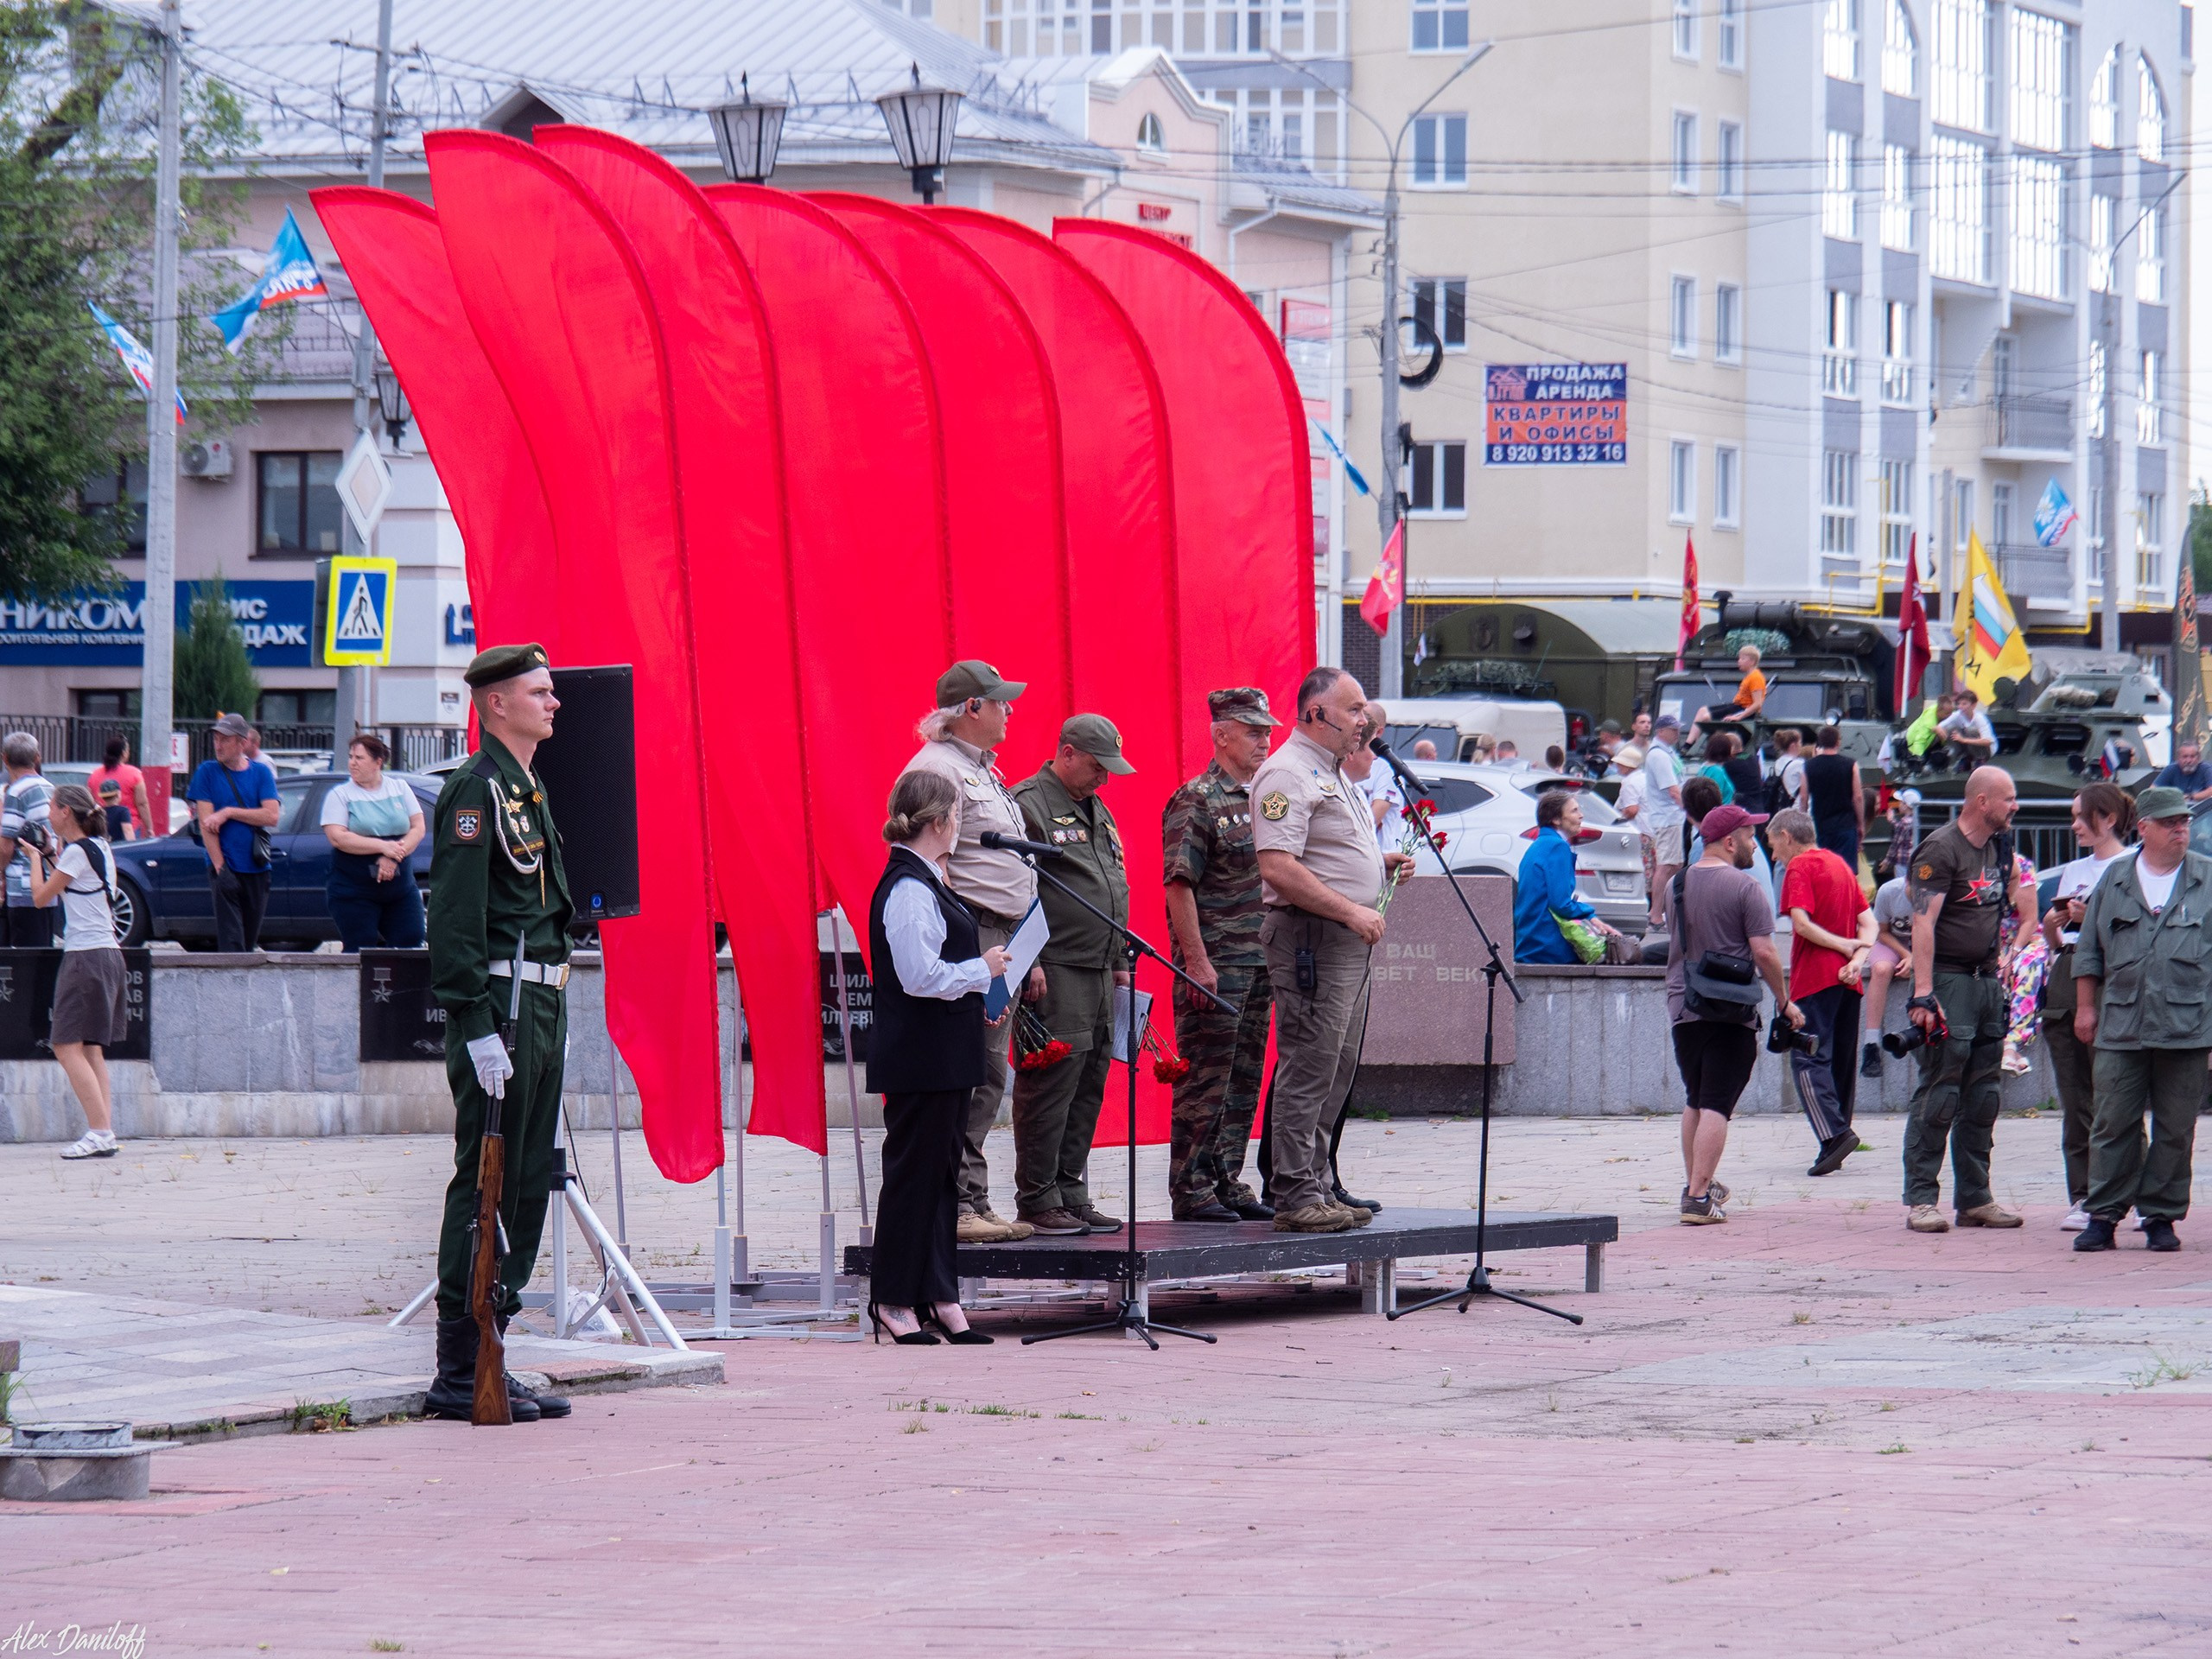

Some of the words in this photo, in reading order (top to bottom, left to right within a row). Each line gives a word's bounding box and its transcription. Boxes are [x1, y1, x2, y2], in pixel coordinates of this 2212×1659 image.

[1526, 365, 1624, 382] ПРОДАЖА
[1535, 385, 1613, 401] АРЕНДА
[1493, 406, 1619, 422] КВАРТИРЫ
[1499, 426, 1513, 441] И
[1528, 426, 1613, 441] ОФИСЫ
[1492, 444, 1503, 461] 8
[1507, 444, 1538, 461] 920
[1541, 444, 1573, 461] 913
[1577, 444, 1598, 461] 32
[1602, 444, 1623, 461] 16
[1386, 944, 1435, 959] ВАШ
[1370, 966, 1417, 982] ВЕТ
